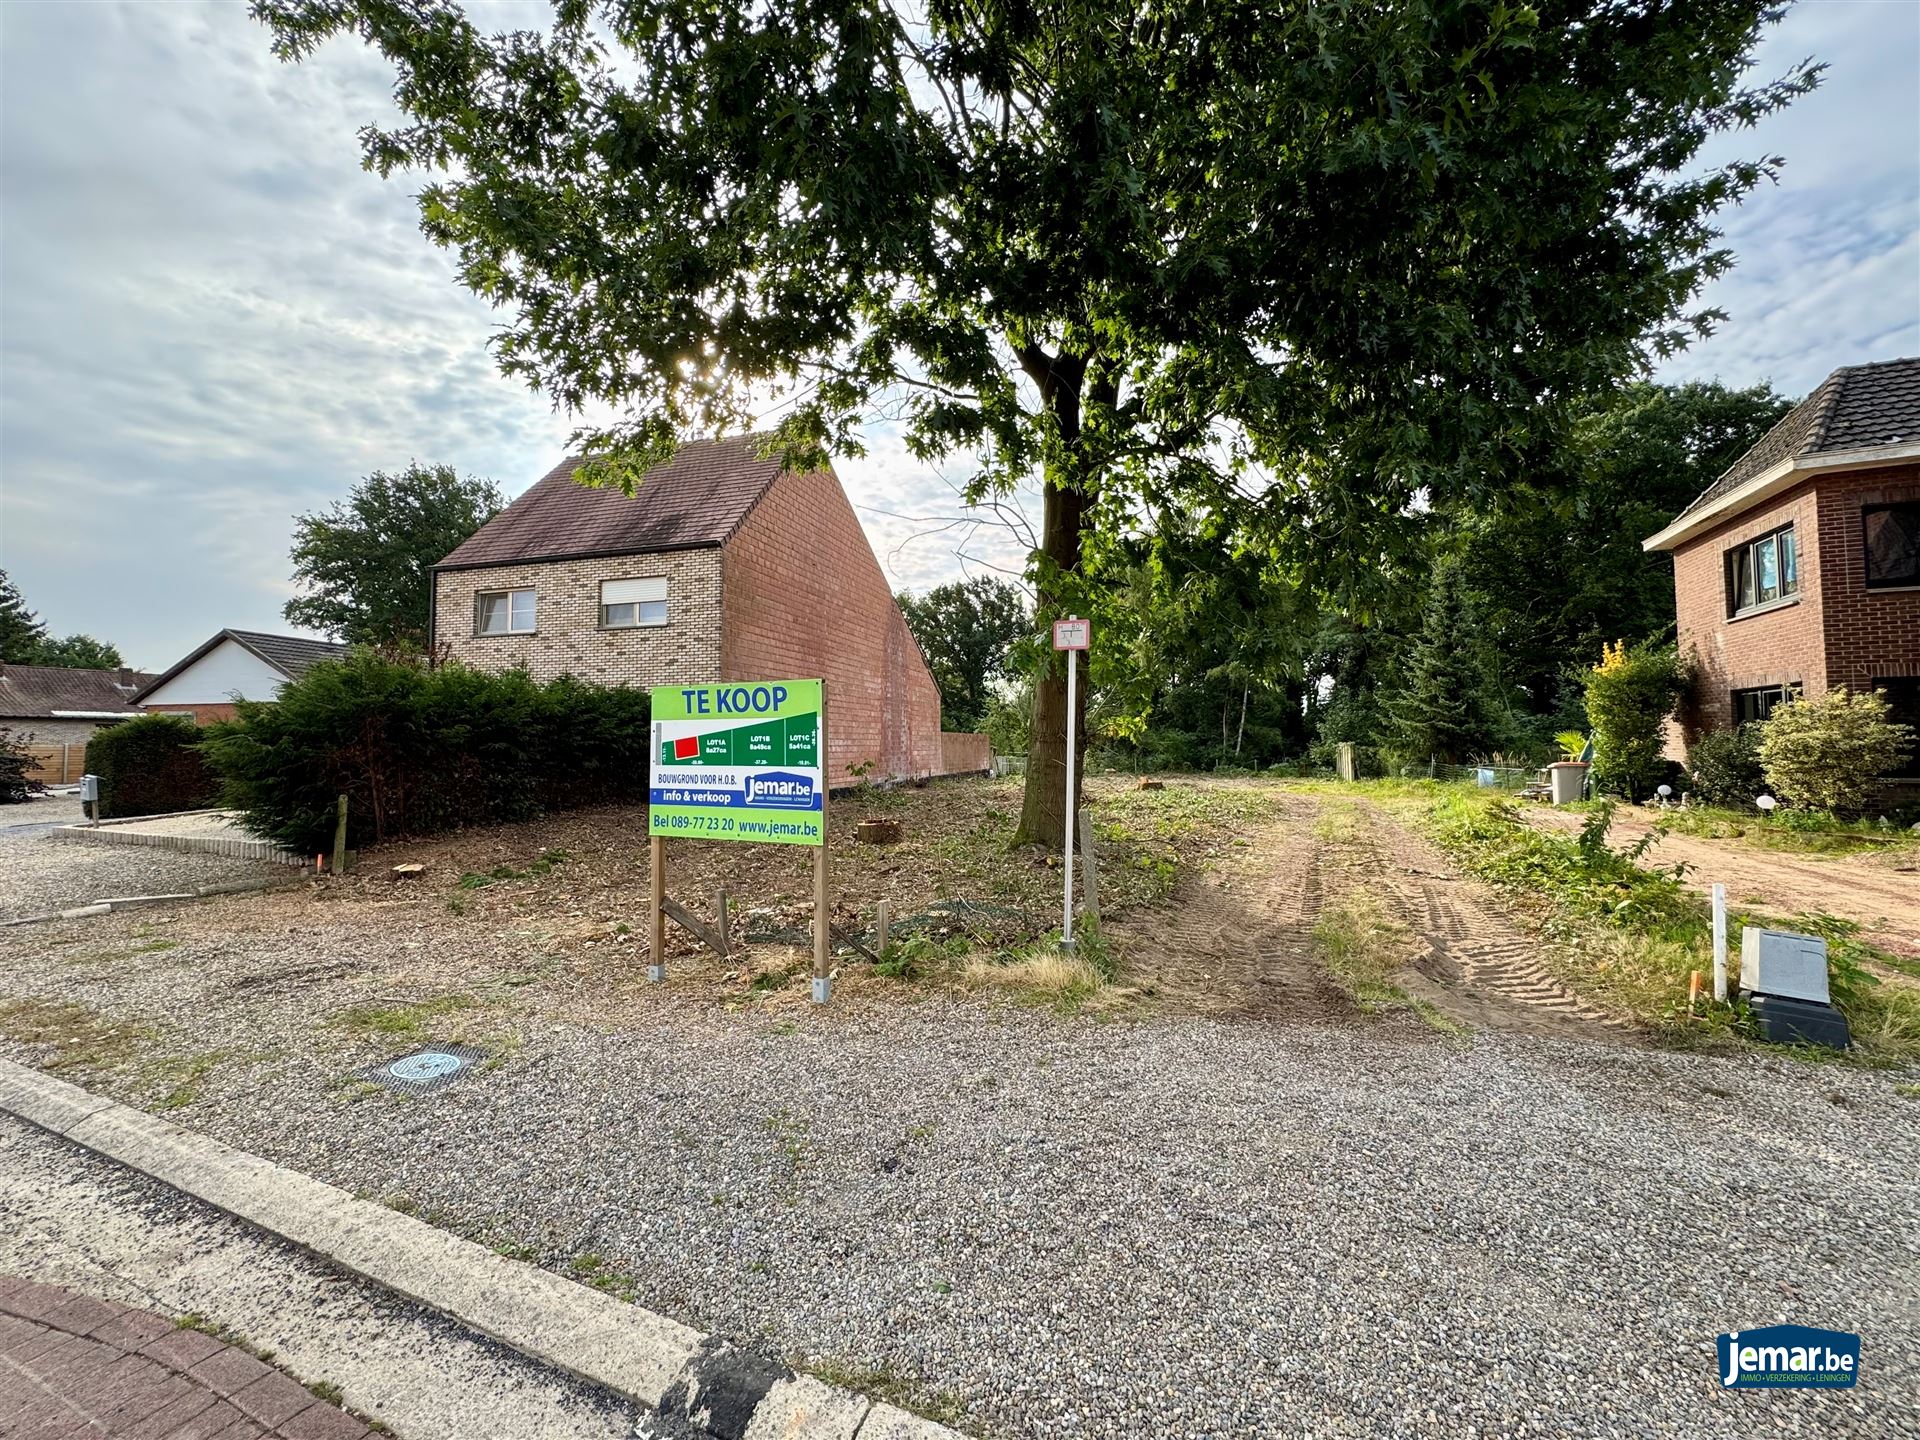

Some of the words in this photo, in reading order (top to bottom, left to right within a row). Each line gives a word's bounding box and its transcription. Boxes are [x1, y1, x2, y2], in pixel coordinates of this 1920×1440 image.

[682, 690, 710, 714] TE
[716, 686, 788, 713] KOOP
[658, 774, 699, 785] BOUWGROND
[700, 774, 717, 785] VOOR
[717, 775, 737, 786] H.O.B.
[746, 775, 811, 802] jemar.be
[663, 790, 682, 801] info
[683, 791, 692, 802] &
[692, 791, 731, 805] verkoop
[653, 815, 669, 828] Bel
[671, 815, 705, 830] 089-77
[707, 818, 719, 830] 23
[721, 818, 734, 831] 20
[739, 819, 818, 837] www.jemar.be
